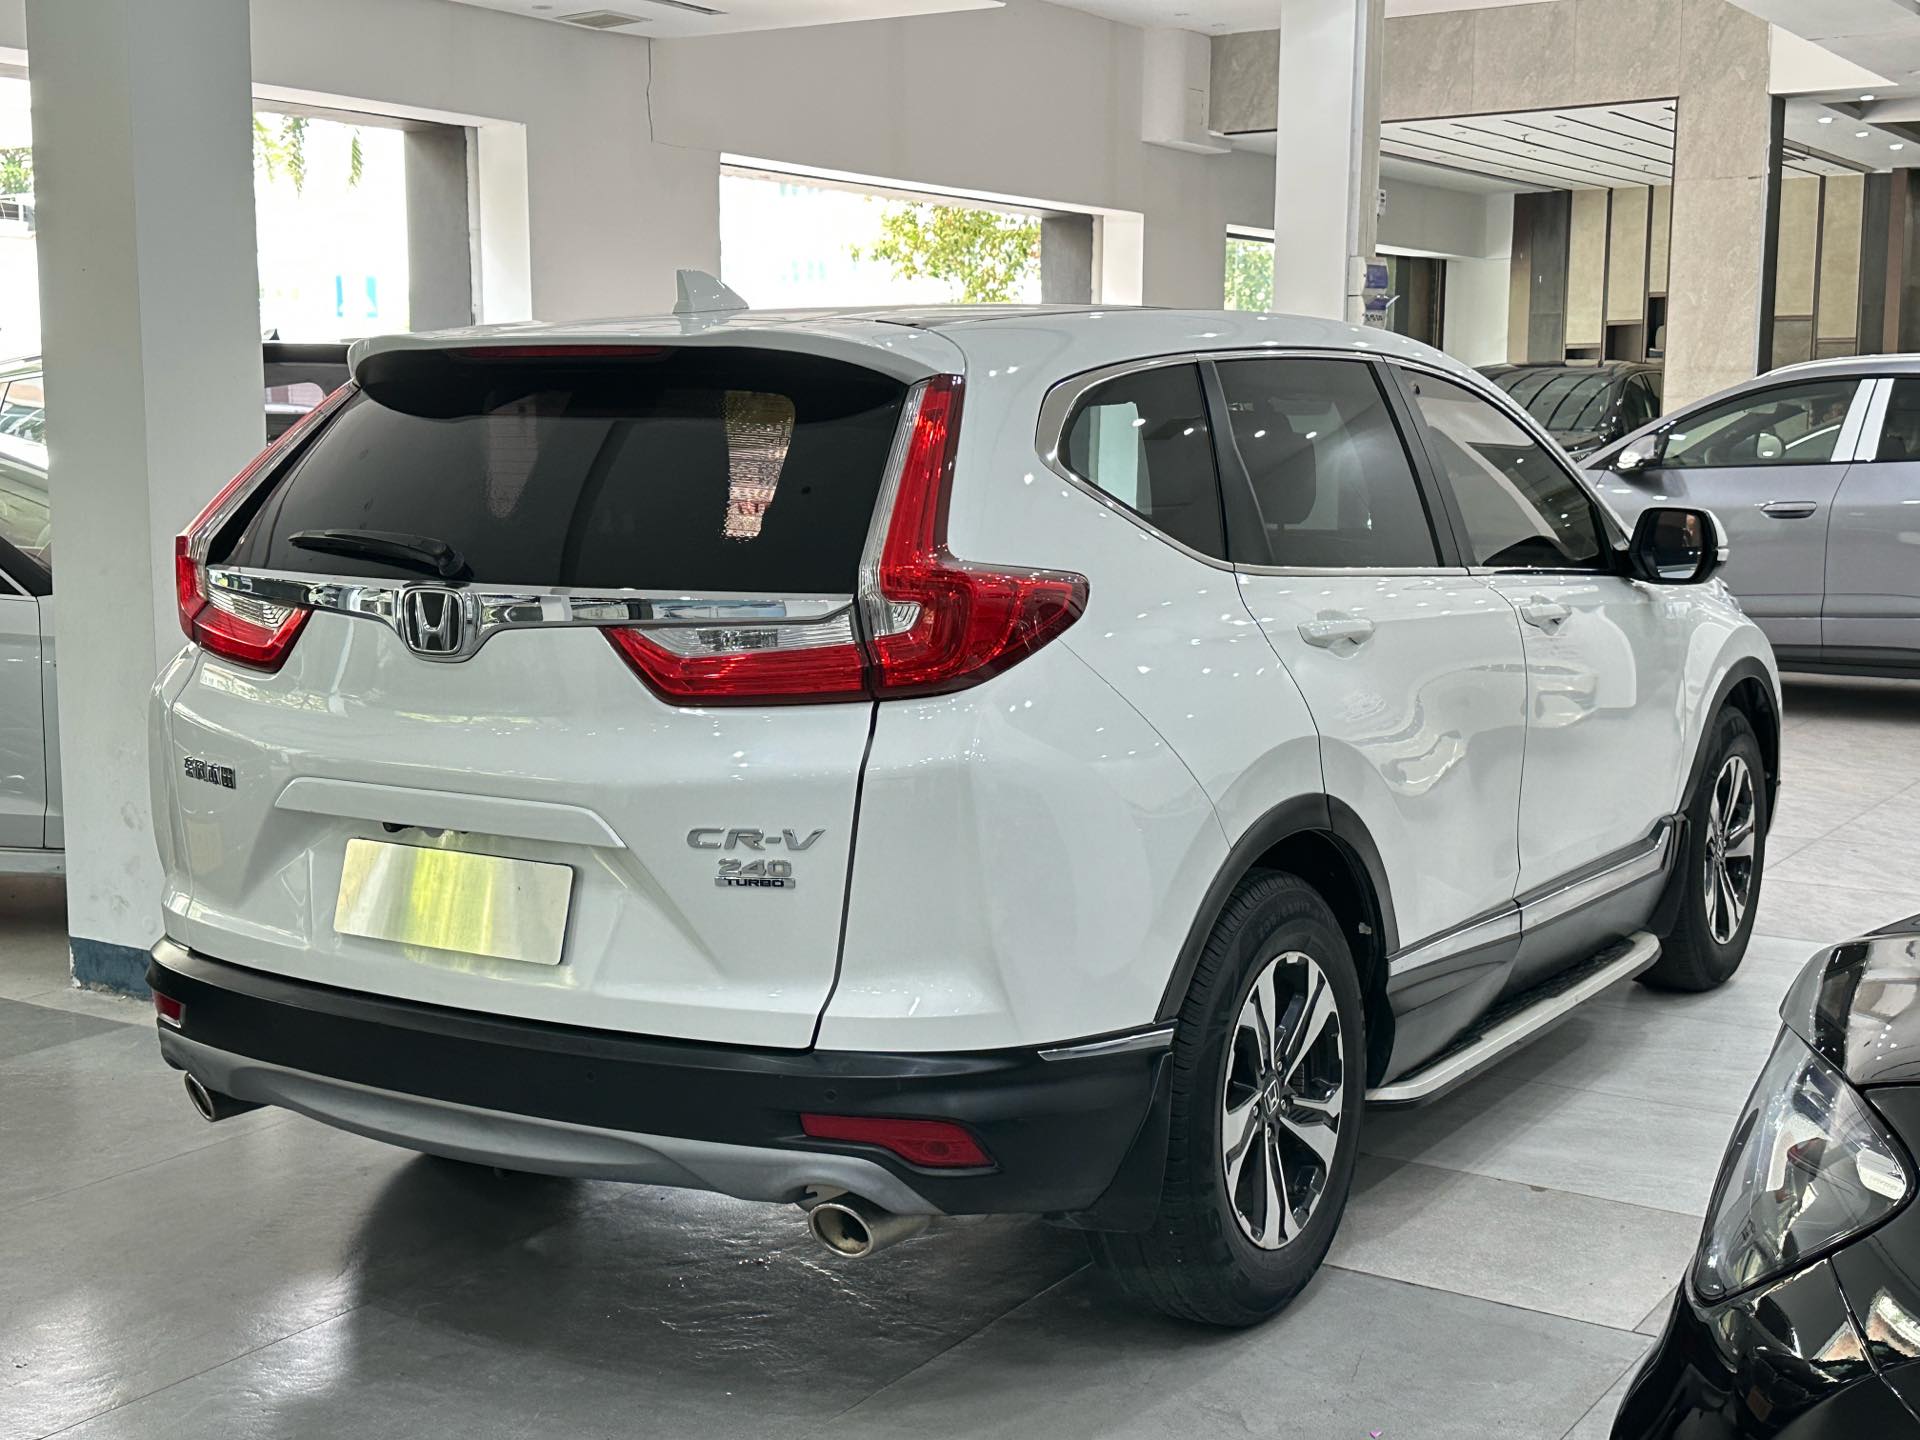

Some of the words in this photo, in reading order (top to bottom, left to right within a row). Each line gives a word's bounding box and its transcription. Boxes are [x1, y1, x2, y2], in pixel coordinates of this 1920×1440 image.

[686, 826, 827, 851] CR-V
[717, 857, 793, 878] 240
[725, 877, 786, 888] TURBO
